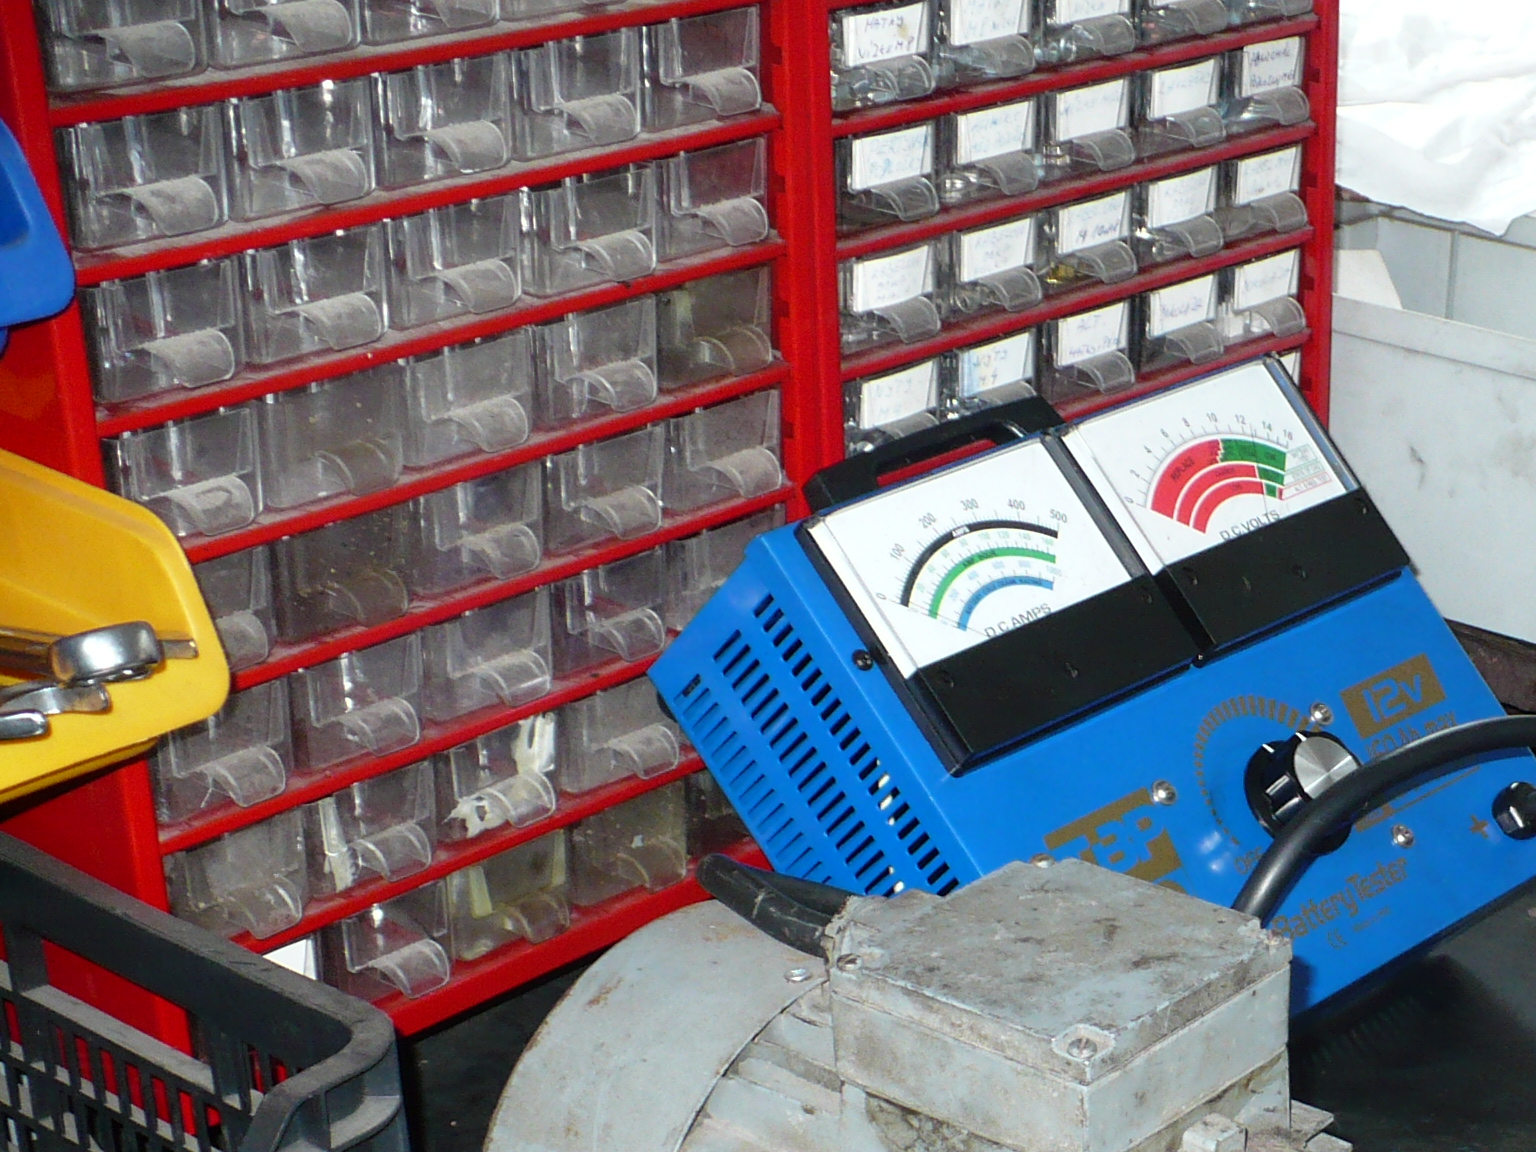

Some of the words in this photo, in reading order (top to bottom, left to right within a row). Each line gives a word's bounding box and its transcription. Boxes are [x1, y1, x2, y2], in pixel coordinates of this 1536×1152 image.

[1206, 412, 1218, 423] 10
[1235, 414, 1246, 426] 12
[1262, 421, 1273, 432] 14
[960, 498, 979, 512] 300
[1008, 499, 1026, 511] 400
[918, 512, 937, 529] 200
[1049, 509, 1067, 523] 500
[889, 543, 905, 561] 100
[1270, 888, 1359, 942] Battery
[1346, 857, 1408, 901] Tester
